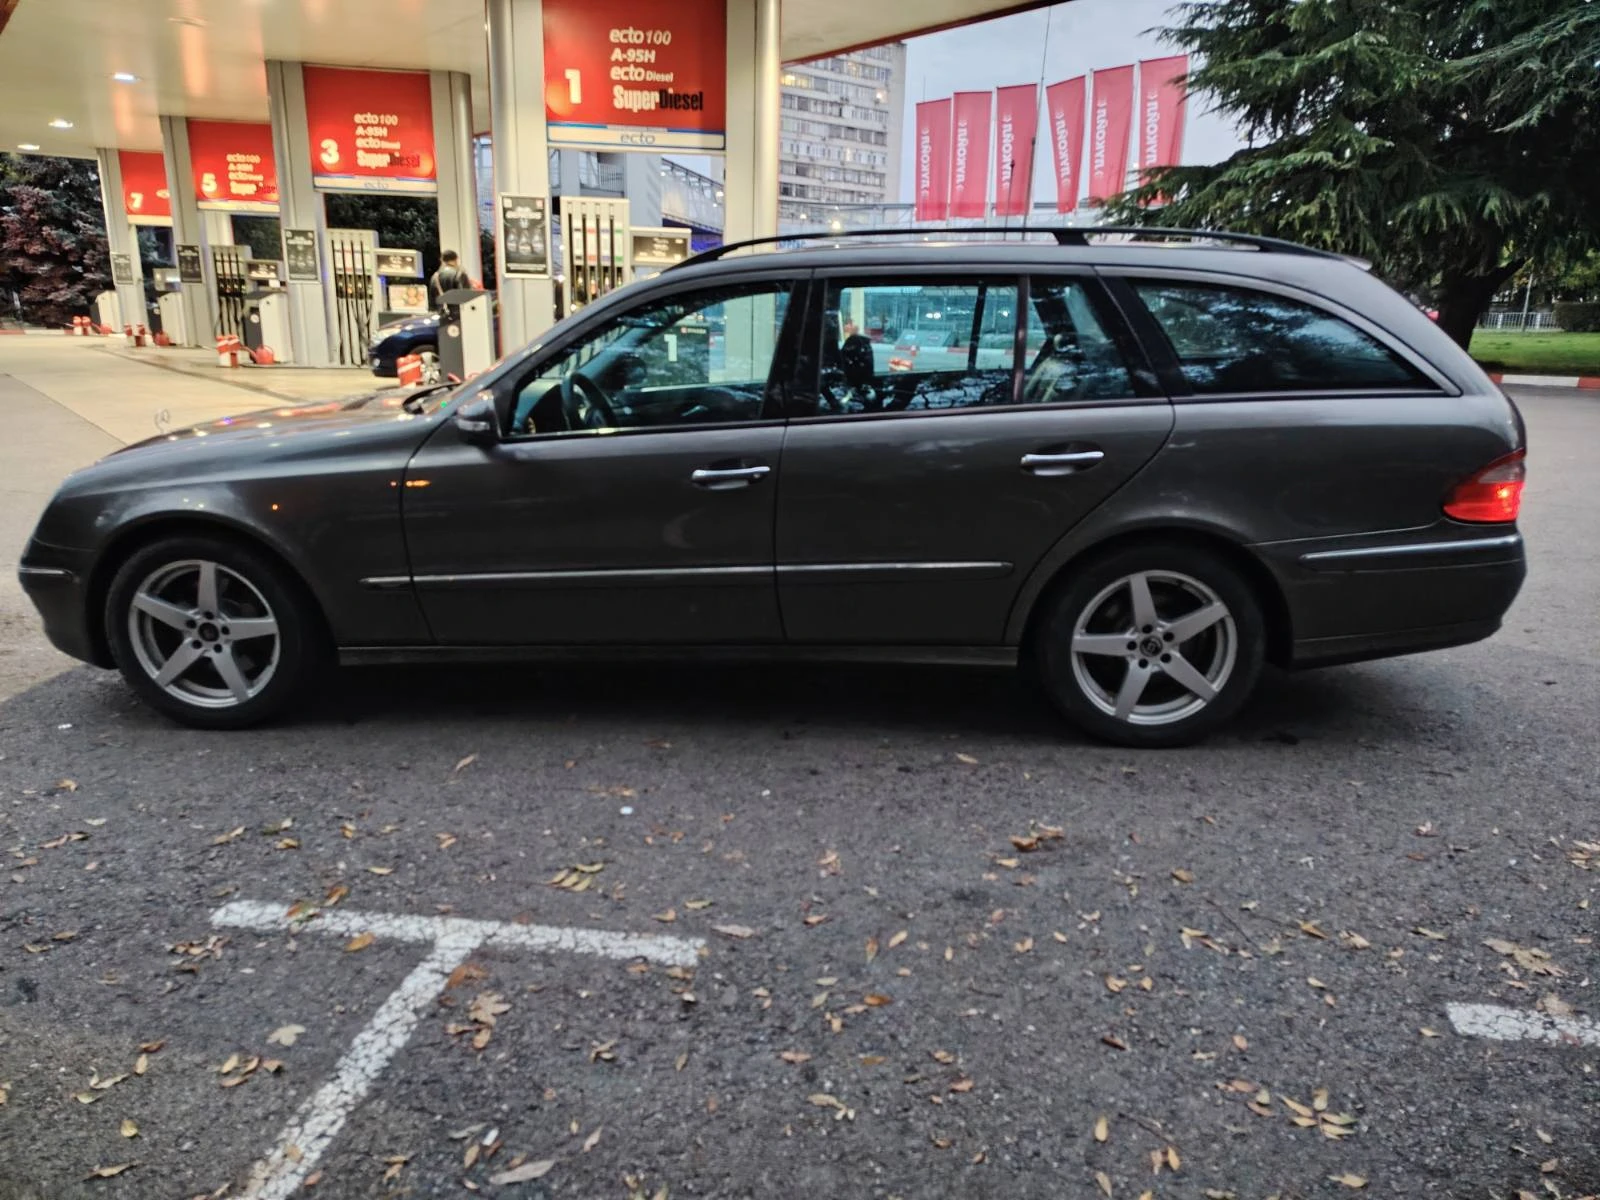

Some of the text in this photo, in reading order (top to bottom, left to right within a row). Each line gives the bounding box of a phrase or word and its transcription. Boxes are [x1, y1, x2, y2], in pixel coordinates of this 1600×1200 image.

[609, 26, 672, 46] ecto 100
[610, 48, 656, 63] A-95H
[610, 64, 674, 83] ecto Diesel
[564, 68, 582, 104] 1
[354, 112, 399, 126] ecto 100
[355, 137, 381, 149] ecto
[620, 132, 656, 145] ecto
[320, 138, 340, 165] 3
[201, 172, 218, 193] 5
[130, 192, 144, 209] 7
[663, 334, 678, 362] 1
